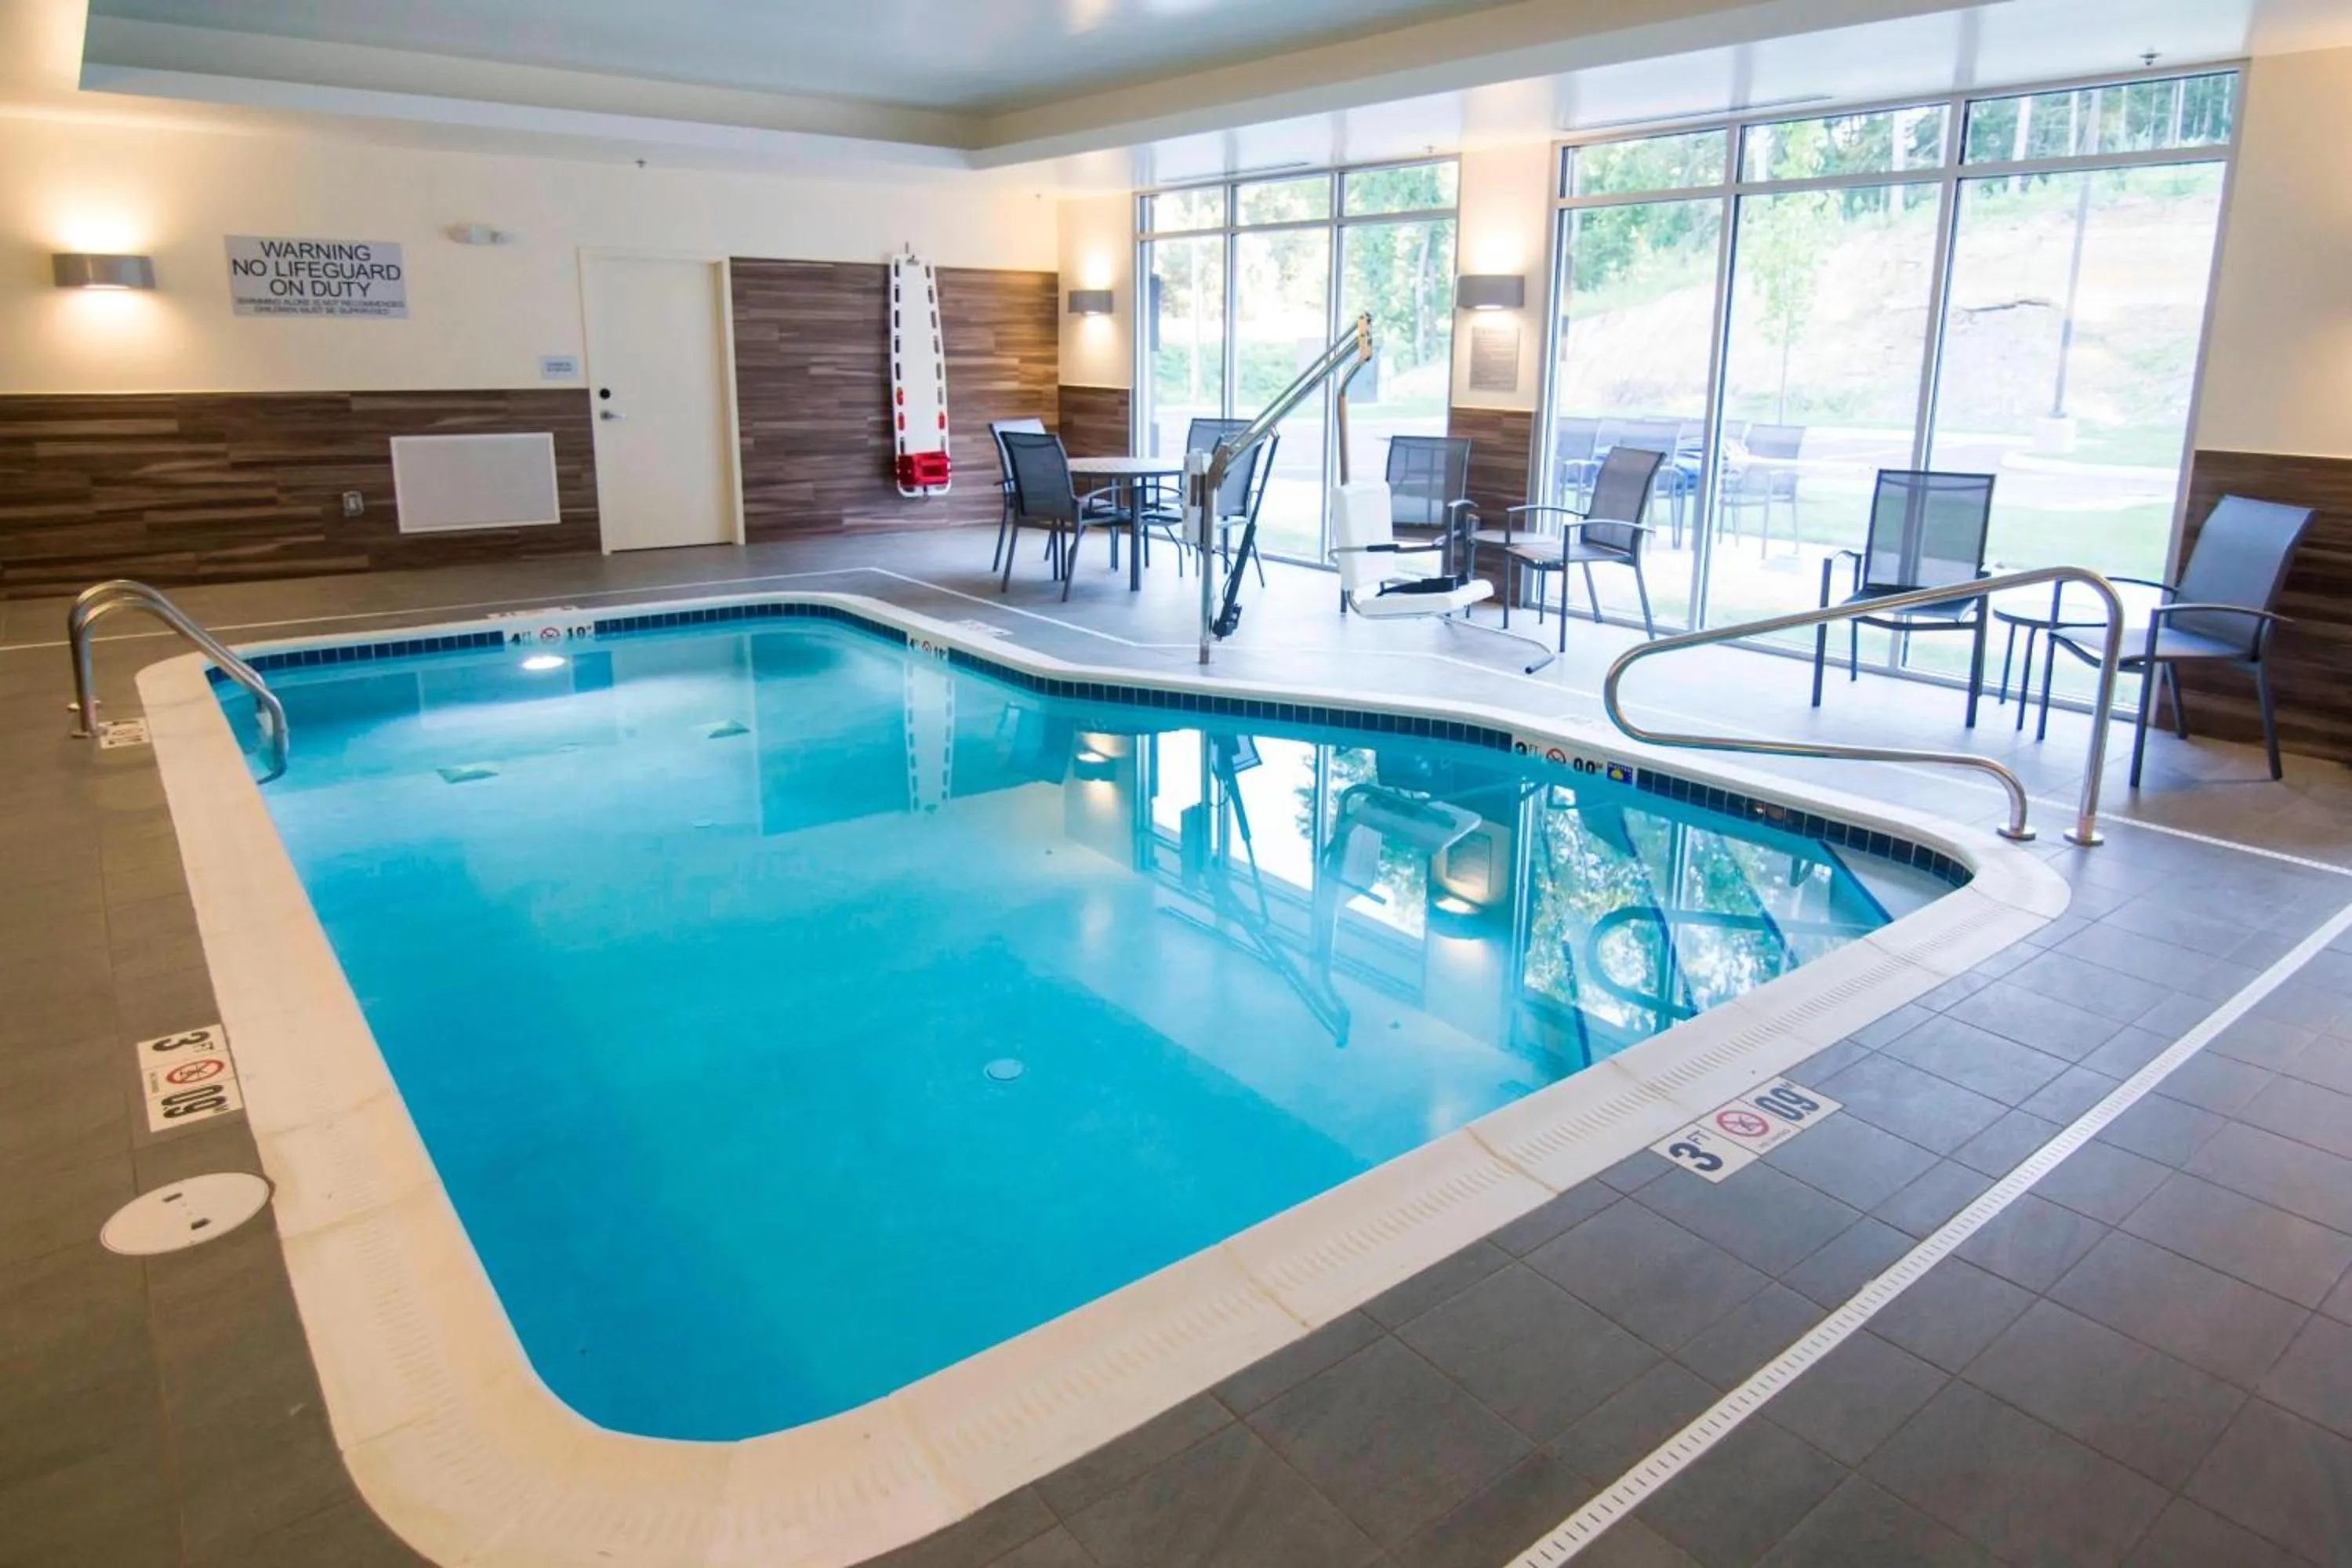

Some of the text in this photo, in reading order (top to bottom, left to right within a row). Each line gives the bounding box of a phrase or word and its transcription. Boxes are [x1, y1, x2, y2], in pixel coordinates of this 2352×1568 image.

[260, 241, 372, 261] WARNING
[232, 260, 401, 281] NO LIFEGUARD
[270, 279, 372, 297] ON DUTY
[152, 1032, 210, 1051] 3
[1686, 1130, 1711, 1145] FT
[1668, 1142, 1723, 1172] 3
